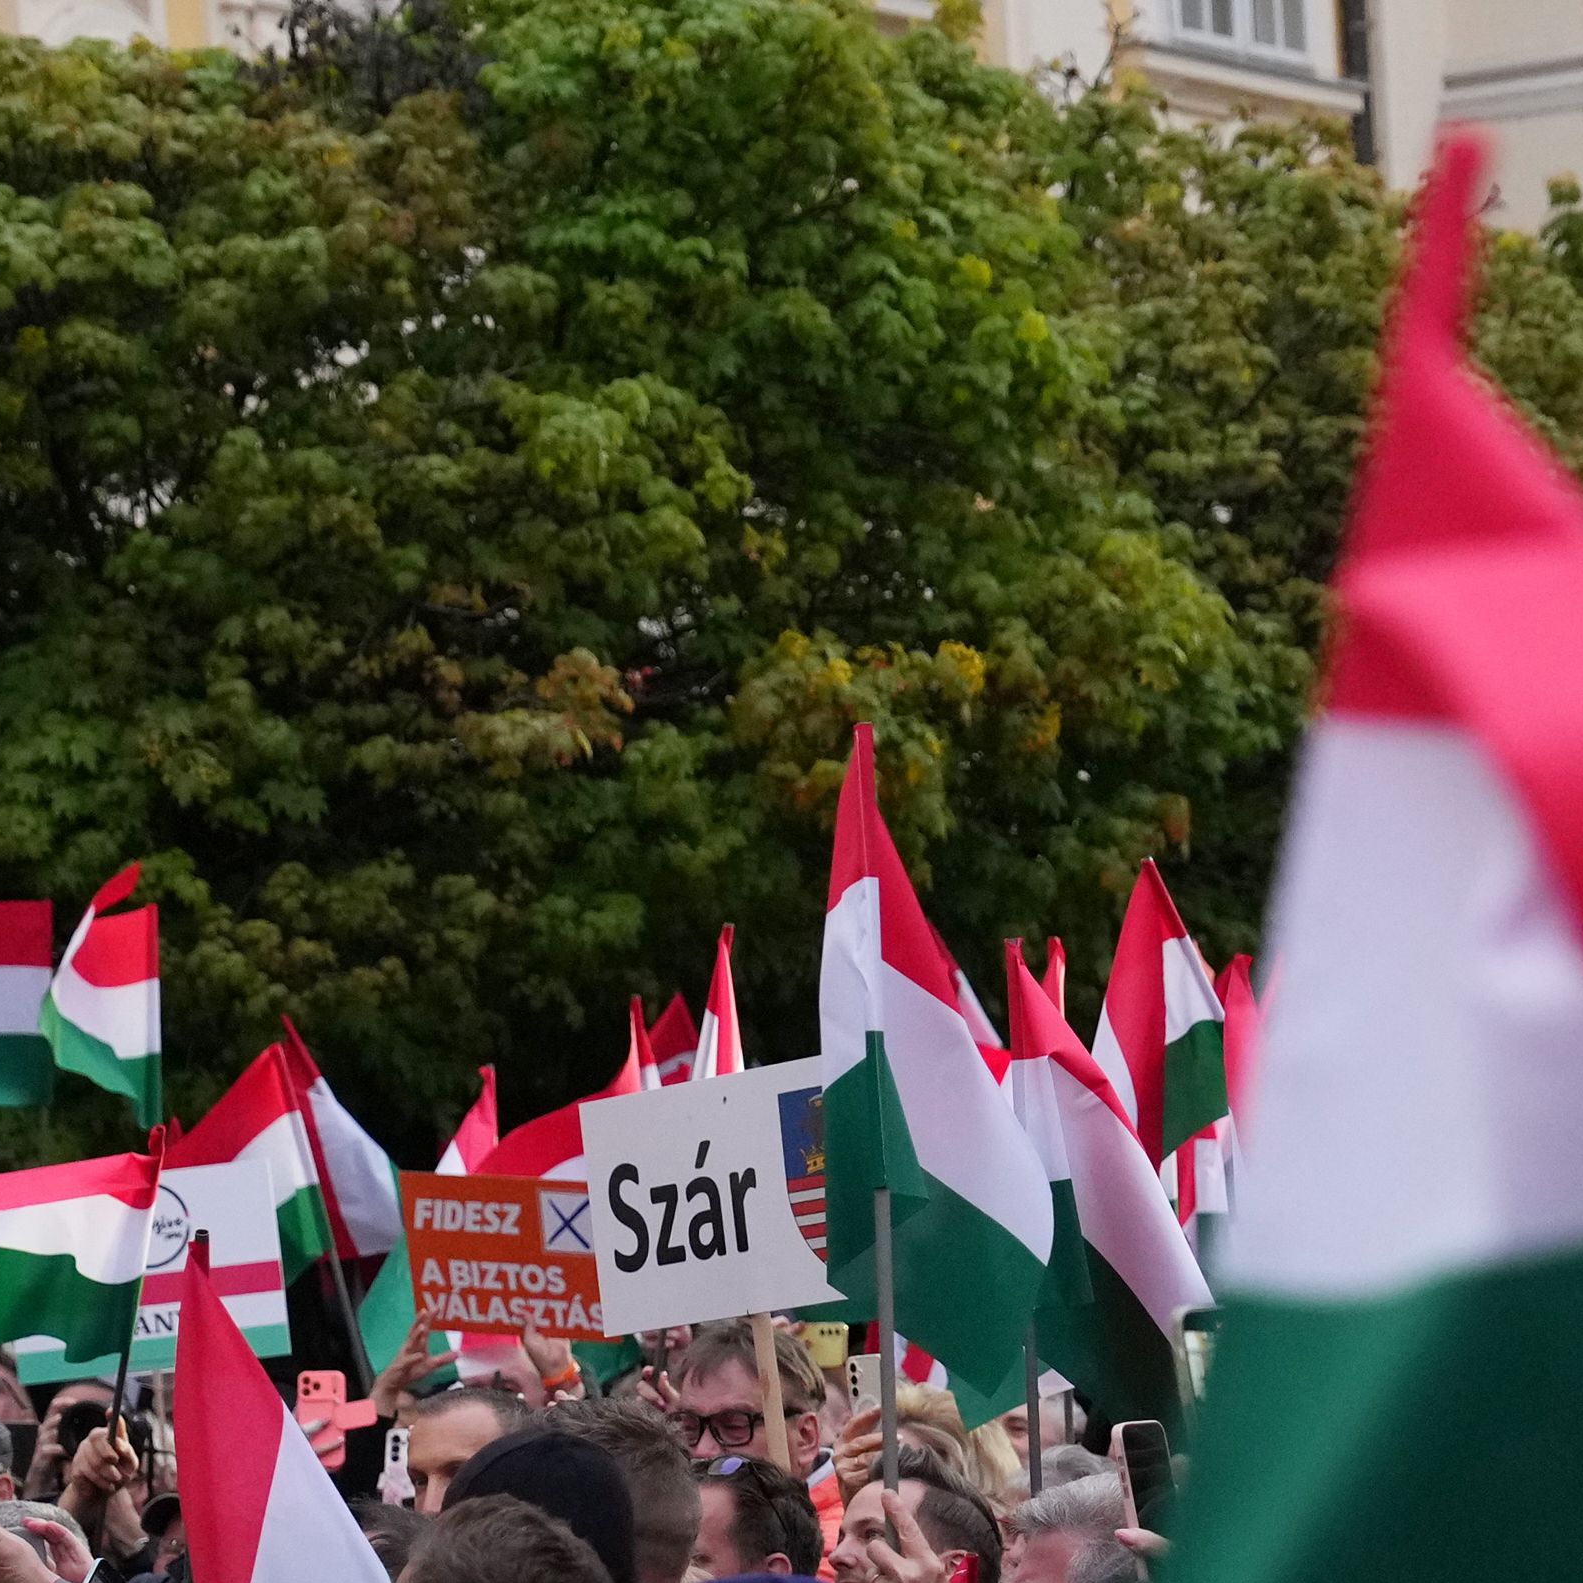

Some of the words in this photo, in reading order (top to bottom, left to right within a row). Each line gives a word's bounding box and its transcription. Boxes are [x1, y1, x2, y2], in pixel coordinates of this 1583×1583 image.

[413, 1197, 522, 1236] FIDESZ
[608, 1139, 757, 1273] Szár
[421, 1257, 446, 1286] A
[447, 1258, 567, 1295] BIZTOS
